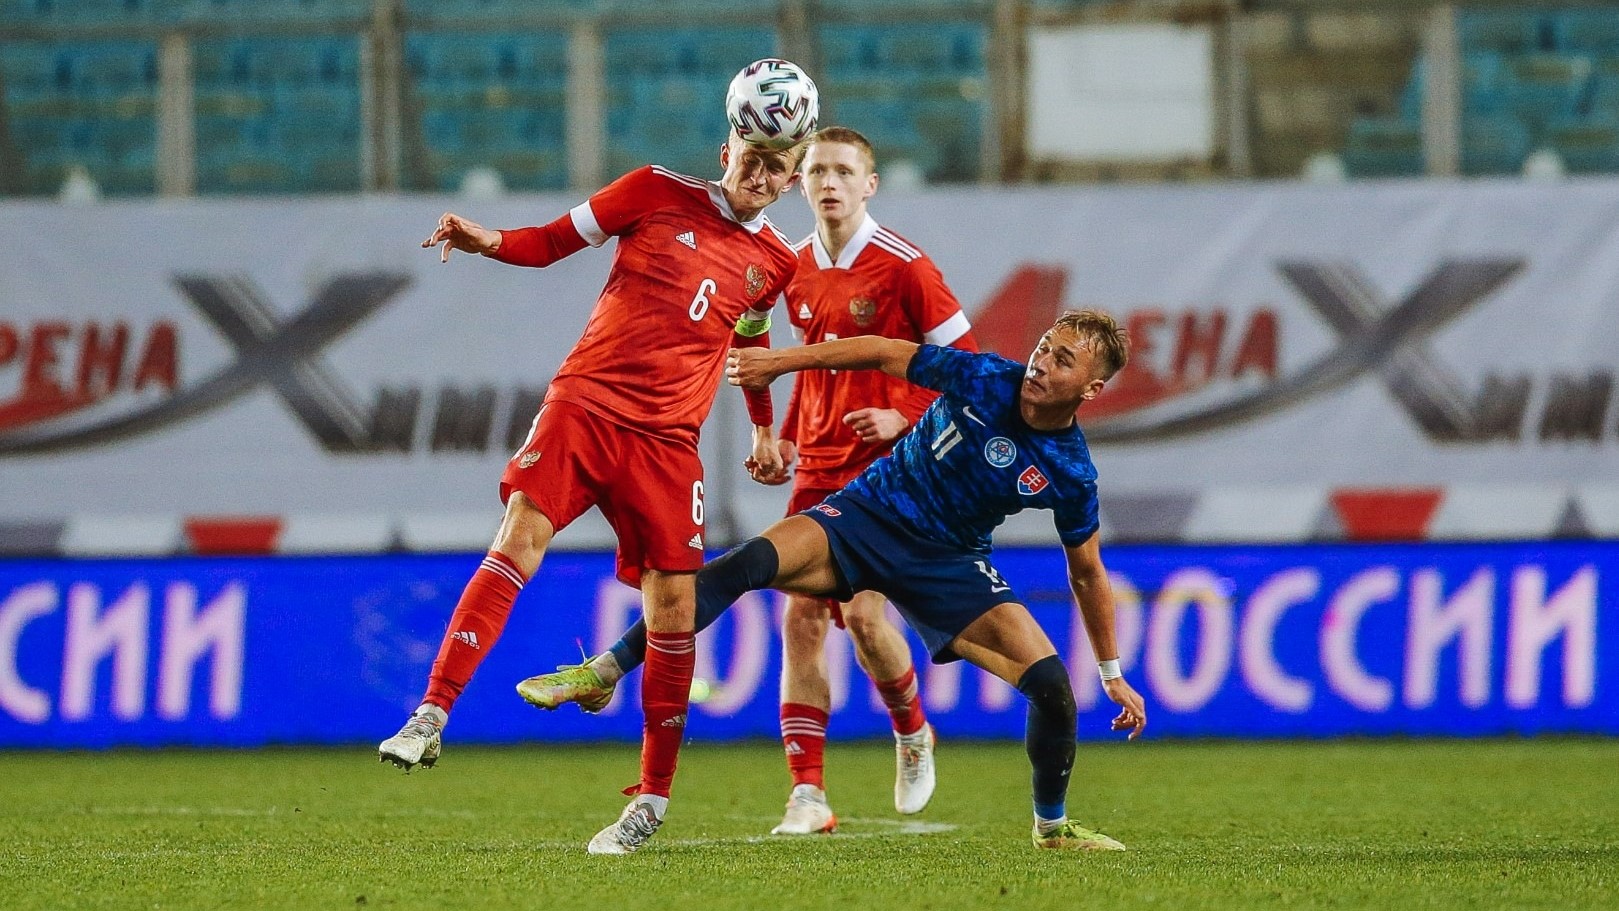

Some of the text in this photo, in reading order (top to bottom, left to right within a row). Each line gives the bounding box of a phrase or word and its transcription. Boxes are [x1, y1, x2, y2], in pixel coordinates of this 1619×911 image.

[688, 278, 717, 321] 6
[966, 257, 1619, 444] АЕНА ХИМ
[931, 420, 963, 461] 11
[692, 480, 704, 526] 6
[1068, 564, 1600, 714] РОССИИ
